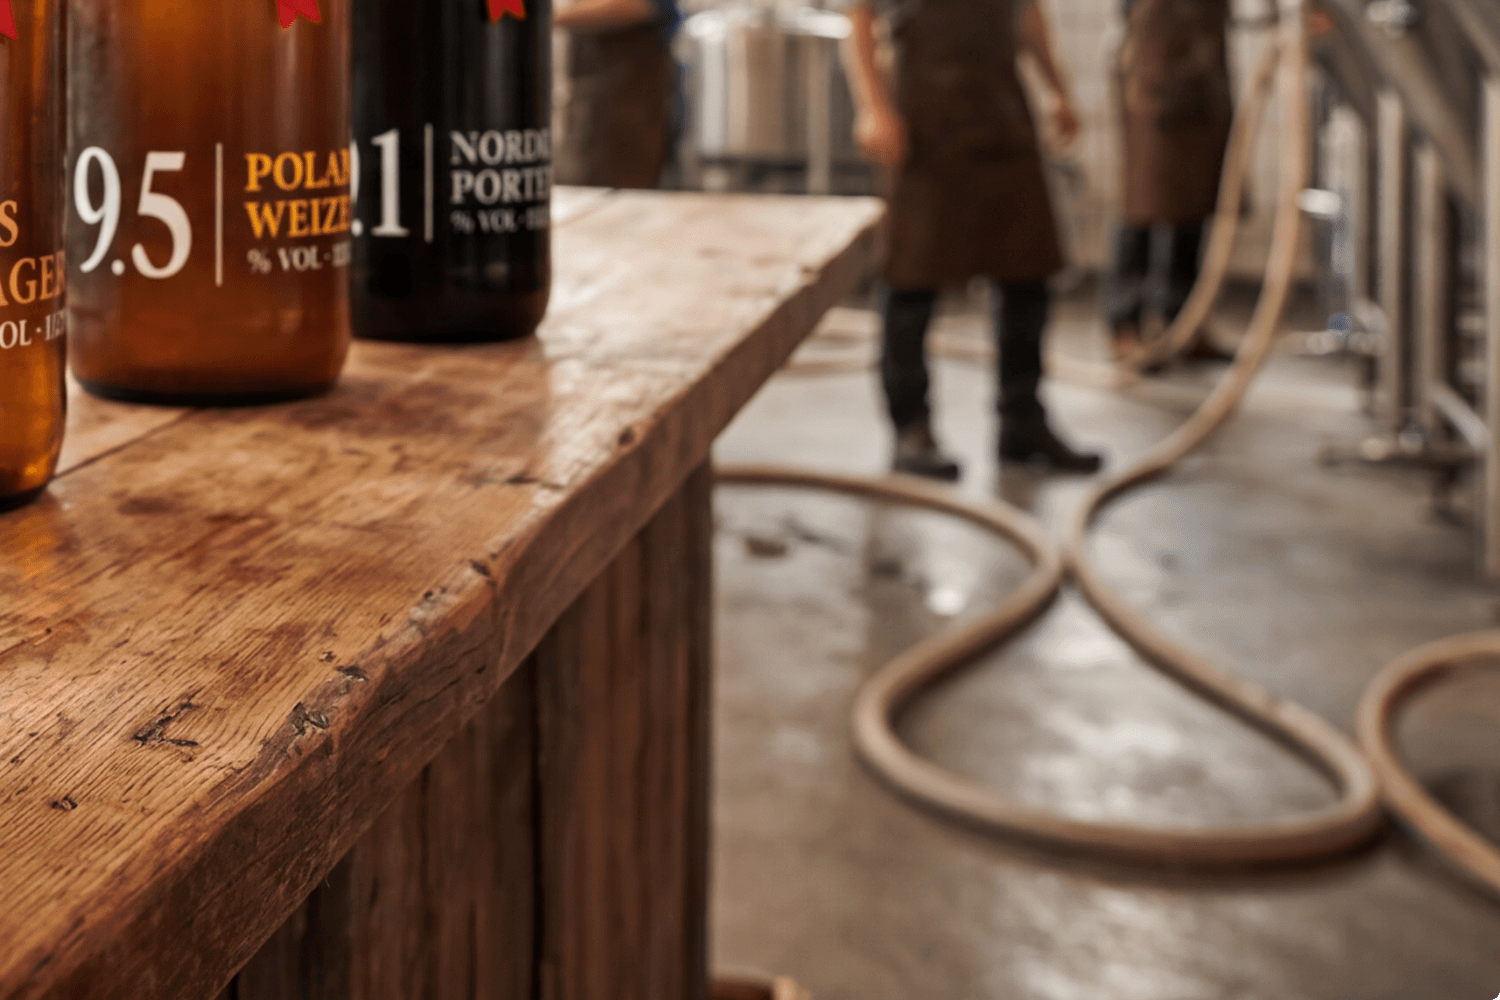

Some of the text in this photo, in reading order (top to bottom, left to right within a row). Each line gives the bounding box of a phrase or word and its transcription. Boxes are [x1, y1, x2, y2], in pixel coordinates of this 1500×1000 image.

[73, 146, 192, 279] 9.5
[247, 247, 273, 275] %
[277, 245, 324, 273] VOL
